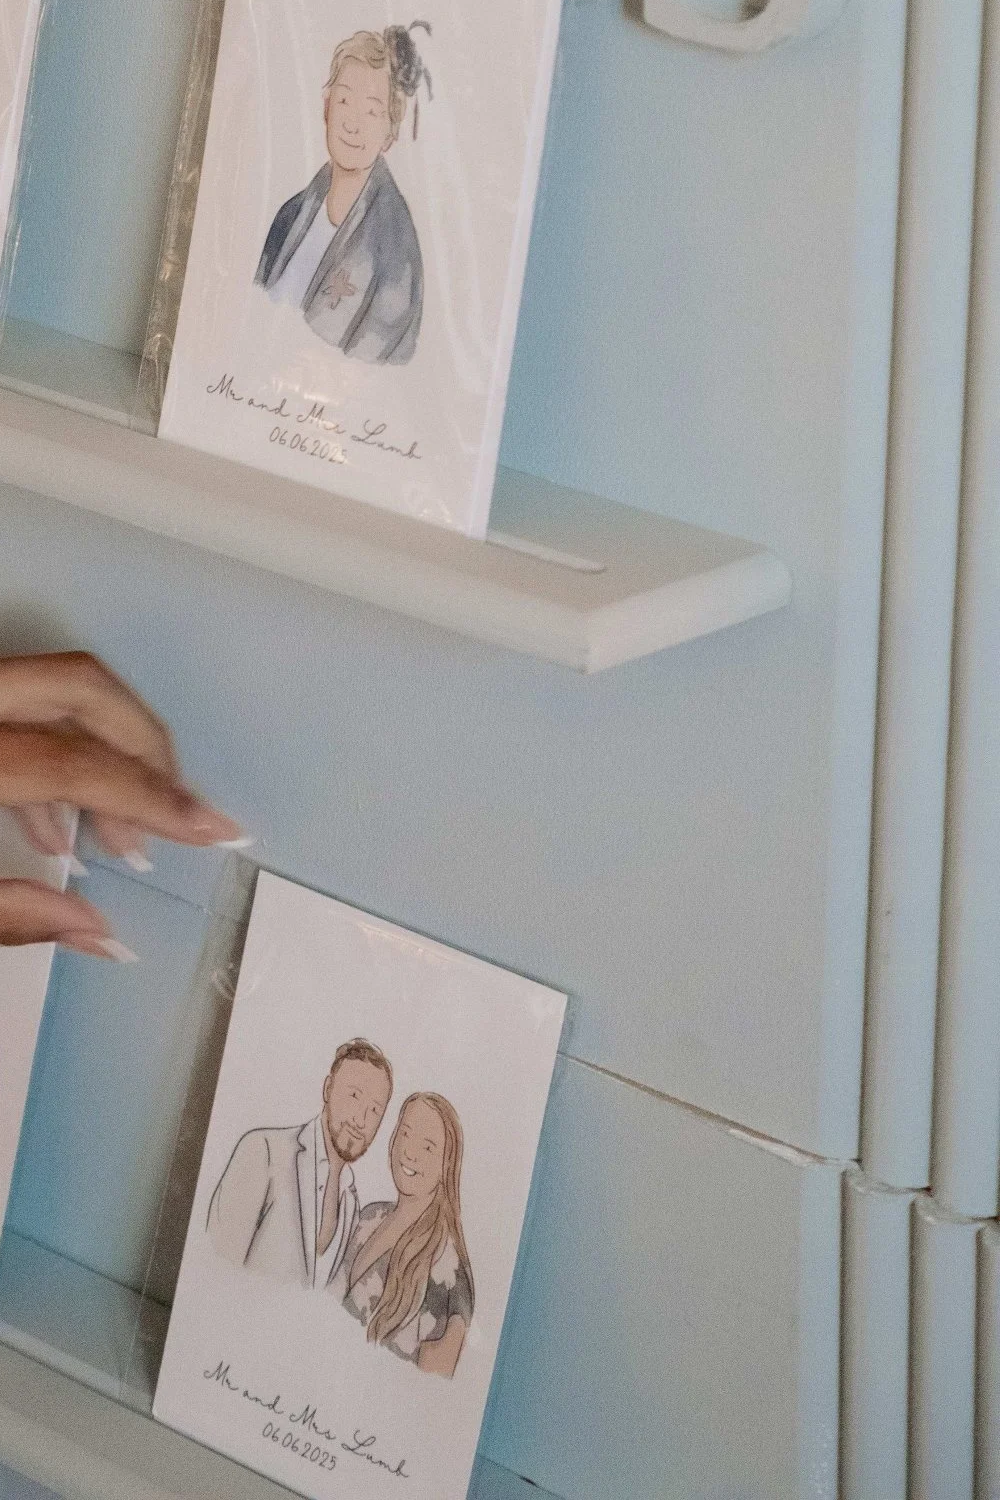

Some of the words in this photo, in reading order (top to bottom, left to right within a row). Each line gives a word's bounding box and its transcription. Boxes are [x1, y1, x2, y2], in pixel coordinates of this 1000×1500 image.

[206, 373, 243, 401] Mr
[247, 396, 290, 418] and
[203, 1359, 239, 1392] Mr
[242, 1390, 284, 1415] and
[289, 1403, 337, 1441] Mrs
